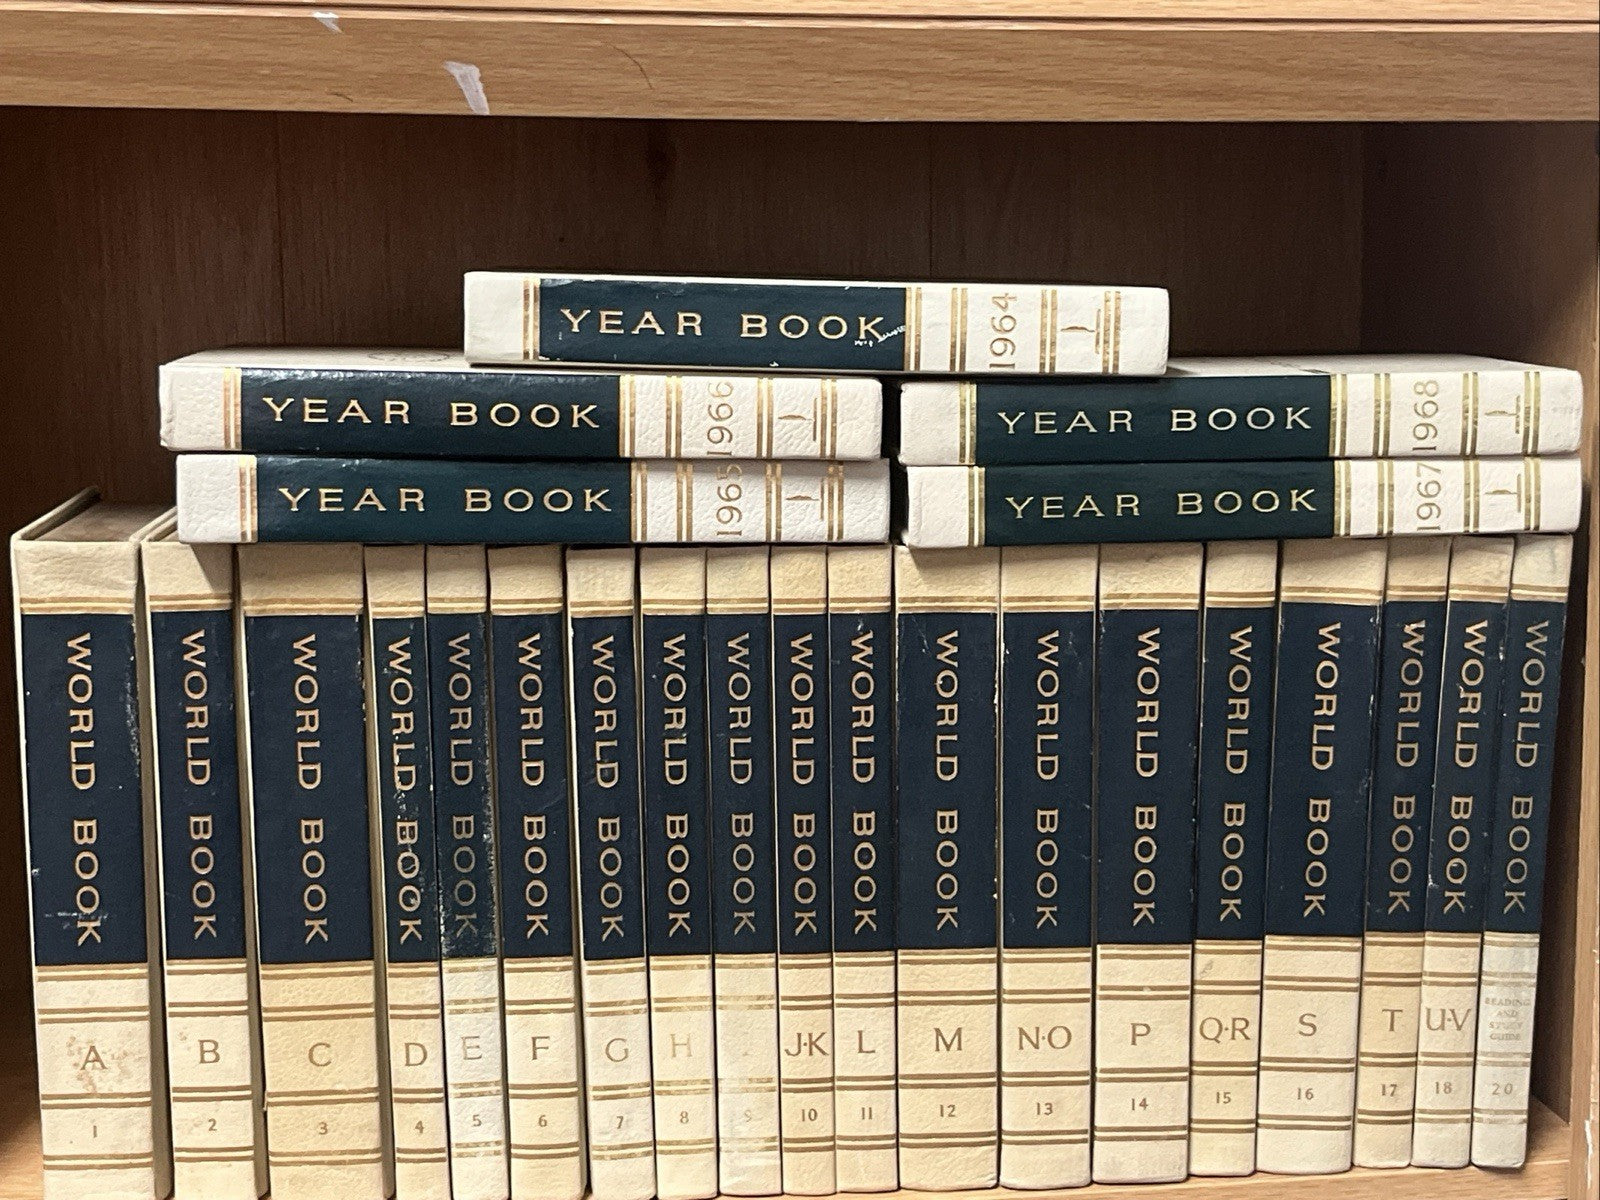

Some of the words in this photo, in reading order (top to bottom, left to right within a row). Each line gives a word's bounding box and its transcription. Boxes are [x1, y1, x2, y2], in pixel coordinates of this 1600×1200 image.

[561, 307, 703, 338] YEAR
[740, 313, 885, 340] BOOK
[988, 292, 1018, 370] 1964
[262, 396, 410, 426] YEAR
[450, 403, 600, 429] BOOK
[707, 382, 733, 455] 1966
[997, 409, 1132, 434] YEAR
[1170, 406, 1312, 432] BOOK
[1412, 380, 1439, 451] 1968
[279, 486, 425, 513] YEAR
[465, 488, 610, 513] BOOK
[716, 464, 742, 536] 1965
[1005, 494, 1140, 520] YEAR
[1177, 488, 1316, 515] BOOK
[1417, 463, 1441, 531] 1967
[67, 632, 96, 790] WORLD
[182, 629, 211, 786] WORLD
[293, 633, 322, 790] WORLD
[387, 636, 417, 791] WORLD
[448, 632, 473, 786] WORLD
[517, 632, 544, 787] WORLD
[591, 634, 619, 788] WORLD
[663, 633, 688, 785] WORLD
[727, 633, 753, 785] WORLD
[790, 633, 814, 785] WORLD
[850, 630, 875, 784] WORLD
[936, 630, 959, 781] WORLD
[1036, 630, 1059, 780] WORLD
[1135, 627, 1161, 777] WORLD
[1225, 626, 1253, 775] WORLD
[1311, 622, 1341, 770] WORLD
[1396, 620, 1426, 768] WORLD
[1454, 620, 1488, 768] WORLD
[1515, 620, 1548, 768] WORLD
[73, 819, 101, 946] BOOK
[189, 815, 217, 940] BOOK
[300, 818, 329, 944] BOOK
[396, 819, 422, 944] BOOK
[452, 814, 478, 938] BOOK
[523, 815, 549, 939] BOOK
[598, 816, 624, 942] BOOK
[666, 813, 691, 937] BOOK
[731, 812, 756, 935] BOOK
[793, 813, 817, 936] BOOK
[852, 811, 877, 935] BOOK
[936, 809, 959, 931] BOOK
[1036, 808, 1059, 929] BOOK
[1133, 805, 1158, 927] BOOK
[1219, 802, 1245, 922] BOOK
[1303, 798, 1331, 917] BOOK
[1387, 795, 1415, 914] BOOK
[1443, 795, 1473, 914] BOOK
[1503, 796, 1533, 914] BOOK
[197, 1039, 220, 1064] B
[308, 1042, 332, 1067] C
[403, 1042, 428, 1067] D
[461, 1036, 483, 1061] E
[530, 1036, 551, 1060] F
[605, 1038, 629, 1063] G
[670, 1033, 693, 1058] H
[857, 1030, 875, 1054] L
[934, 1027, 963, 1052] M
[1130, 1023, 1152, 1046] P
[1298, 1013, 1317, 1037] S
[1382, 1009, 1403, 1032] T
[80, 1045, 108, 1071] A
[1297, 1087, 1314, 1101] 16
[1381, 1083, 1398, 1097] 17
[1434, 1082, 1452, 1095] 18
[1492, 1083, 1513, 1095] 20
[92, 1125, 97, 1138] 1
[207, 1118, 217, 1131] 2
[318, 1122, 329, 1135] 3
[414, 1121, 424, 1134] 4
[472, 1114, 482, 1127] 5
[538, 1114, 548, 1127] 6
[616, 1116, 624, 1129] 7
[680, 1111, 689, 1124] 8
[800, 1108, 818, 1122] 10
[861, 1107, 873, 1120] 11
[939, 1104, 956, 1118] 12
[1036, 1103, 1053, 1116] 13
[1131, 1098, 1148, 1111] 14
[1215, 1091, 1232, 1104] 15
